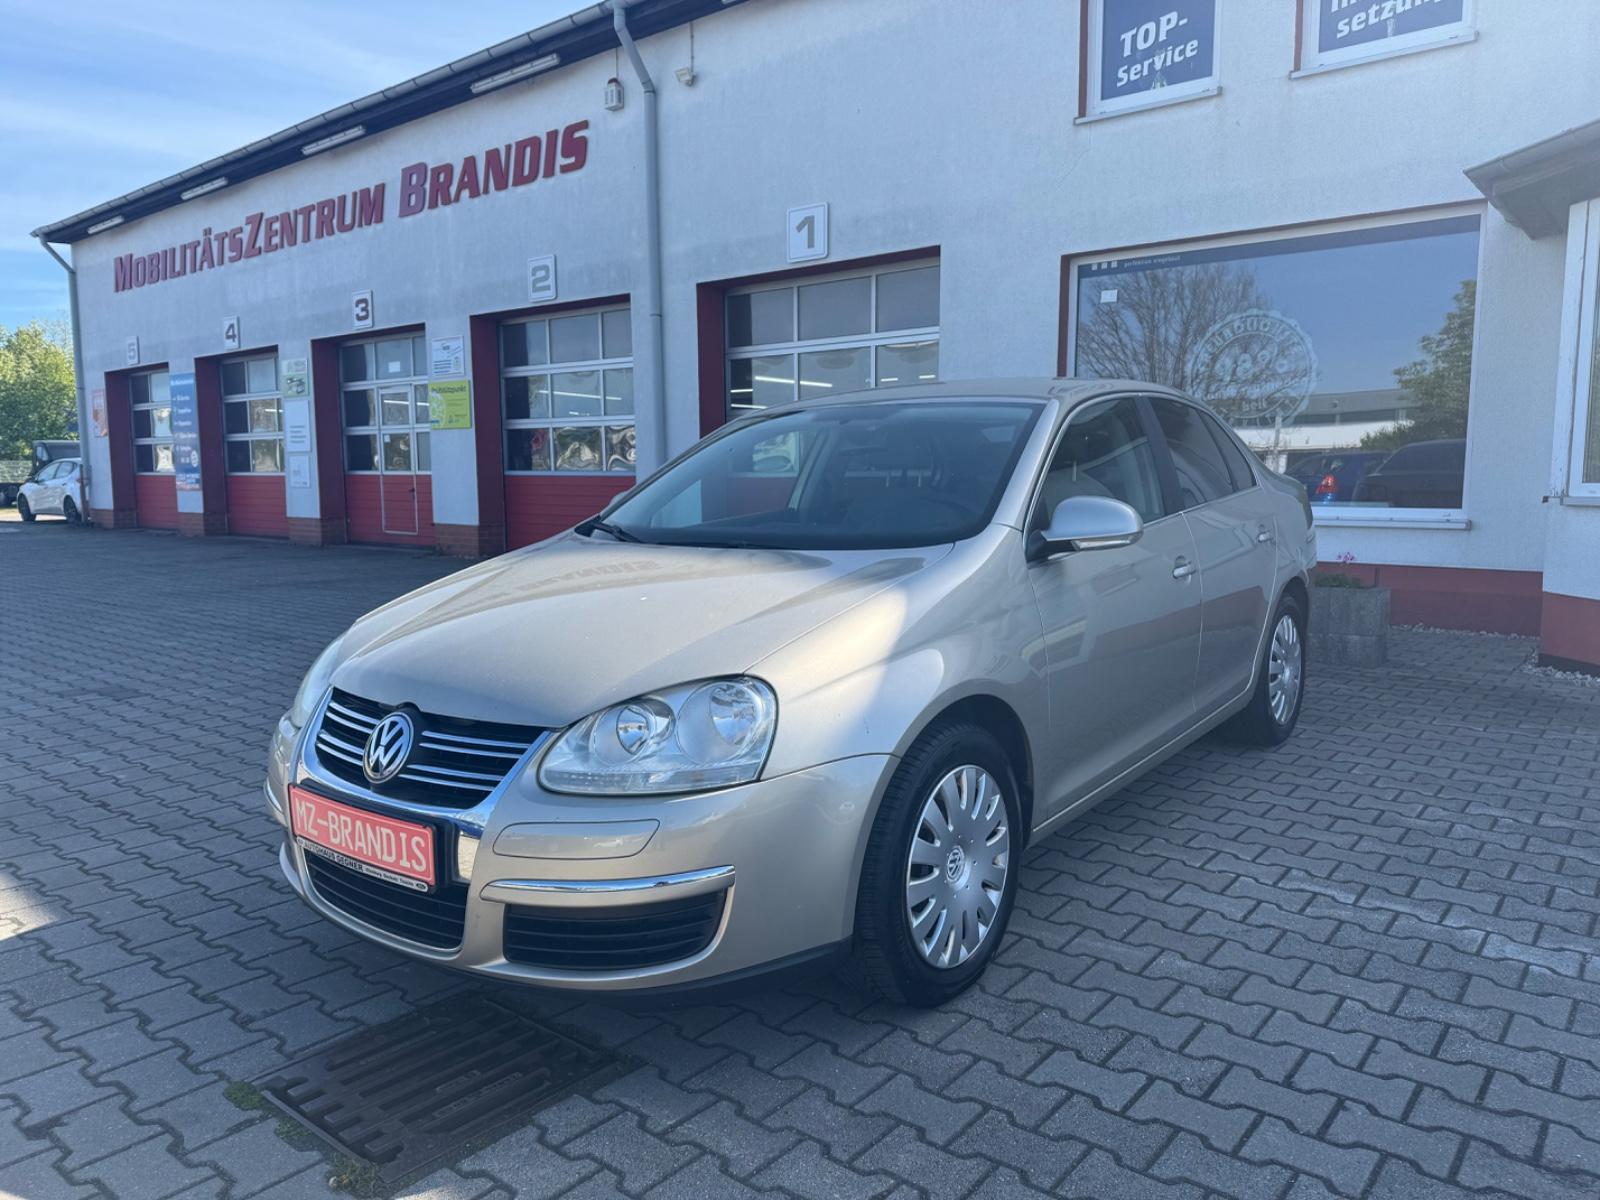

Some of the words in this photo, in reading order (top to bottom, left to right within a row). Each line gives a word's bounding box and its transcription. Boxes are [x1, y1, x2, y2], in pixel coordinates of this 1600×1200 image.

[1120, 11, 1188, 57] TOP-
[1117, 39, 1199, 88] Service
[398, 119, 589, 218] BRANDIS
[796, 215, 814, 249] 1
[531, 264, 551, 293] 2
[355, 298, 369, 321] 3
[225, 323, 237, 342] 4
[127, 344, 137, 362] 5
[296, 798, 427, 872] MZ-BRANDIS
[302, 839, 336, 860] AUTOHAUS
[335, 854, 364, 871] GEGNER
